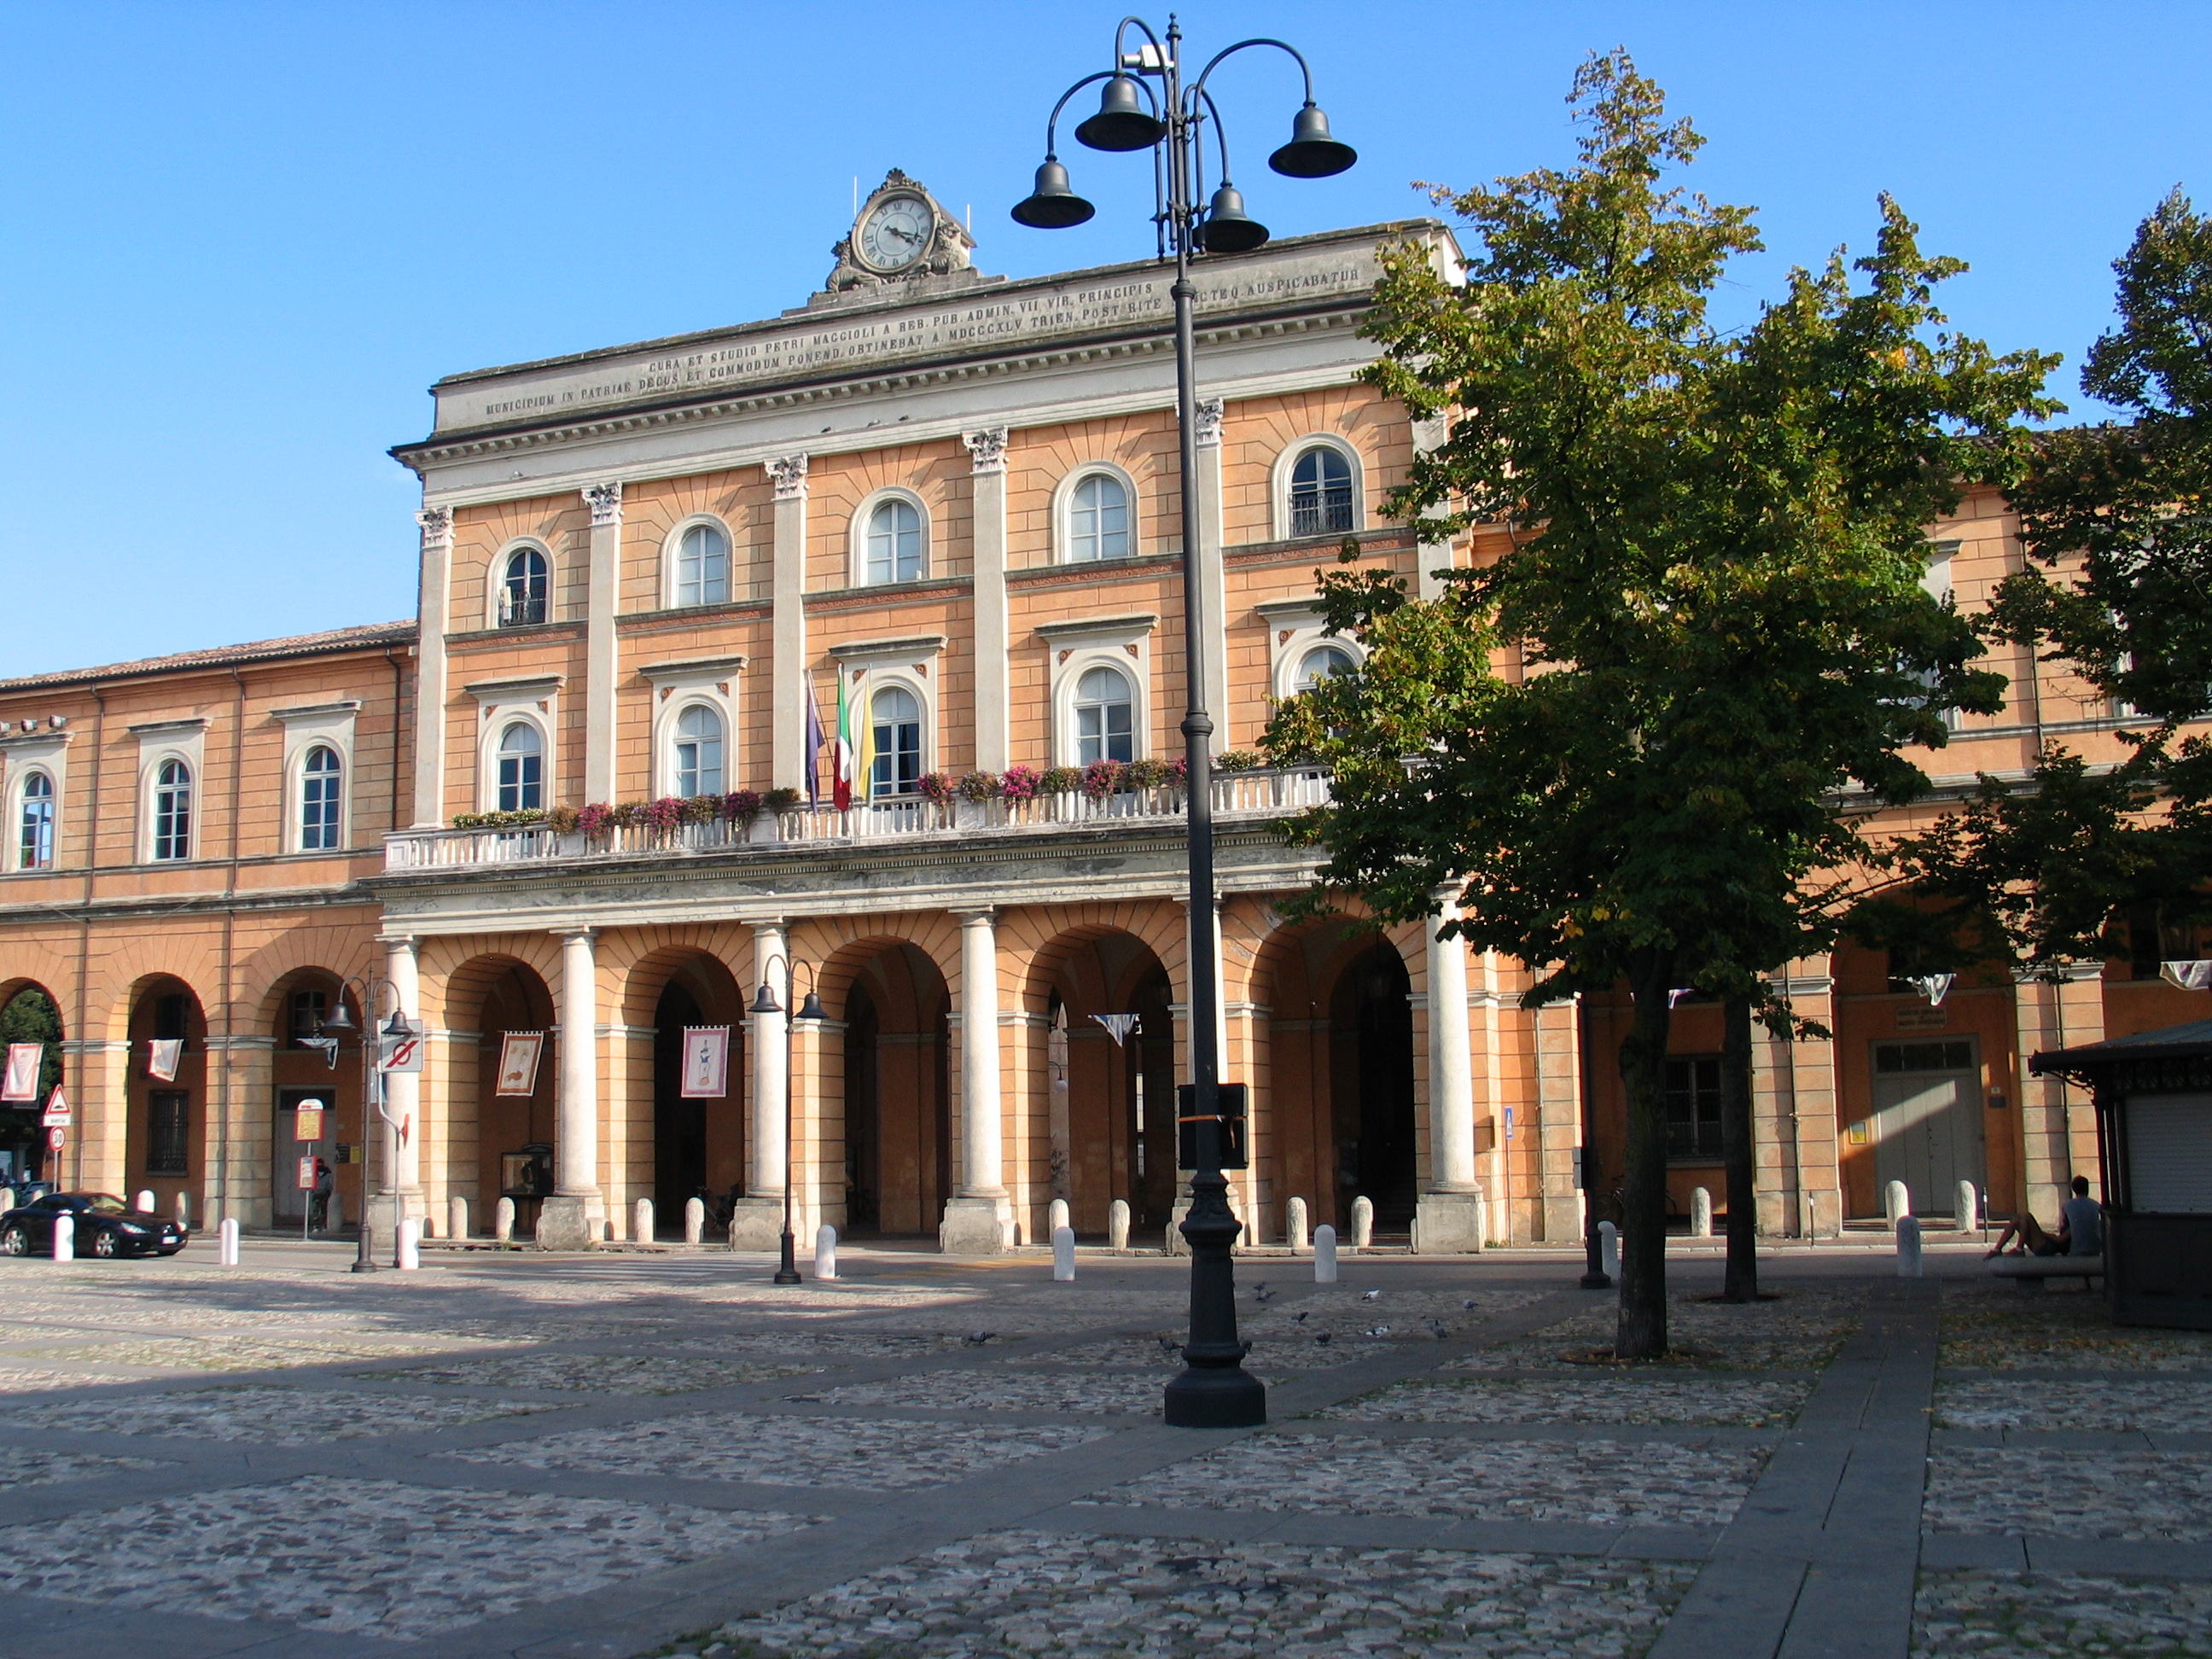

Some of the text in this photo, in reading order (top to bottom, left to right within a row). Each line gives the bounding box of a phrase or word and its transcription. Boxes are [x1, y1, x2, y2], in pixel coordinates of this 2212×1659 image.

[486, 394, 555, 415] MUNICIPIUM
[562, 391, 573, 402] IN
[581, 381, 632, 399] PATRIAE
[639, 374, 678, 390] DECUS
[687, 370, 701, 381] ET
[709, 358, 780, 378] COMMODUM
[848, 335, 923, 356] OBTINEBAT
[949, 318, 1022, 340] MDCCCXLV
[1083, 306, 1120, 320] POST
[1128, 298, 1161, 313] RITE
[1248, 269, 1359, 296] AUSPICABATUR
[650, 358, 680, 372] CURA
[688, 355, 703, 367] ET
[710, 346, 757, 364] STUDIO
[765, 338, 804, 353] PETRI
[883, 323, 890, 334] A
[934, 314, 963, 327] PUB.
[968, 305, 1014, 321] ADMIN.
[1019, 300, 1038, 313] VII
[1047, 297, 1074, 308] VIR.
[1079, 283, 1152, 304] PRINCIPIS
[55, 1133, 62, 1144] 30
